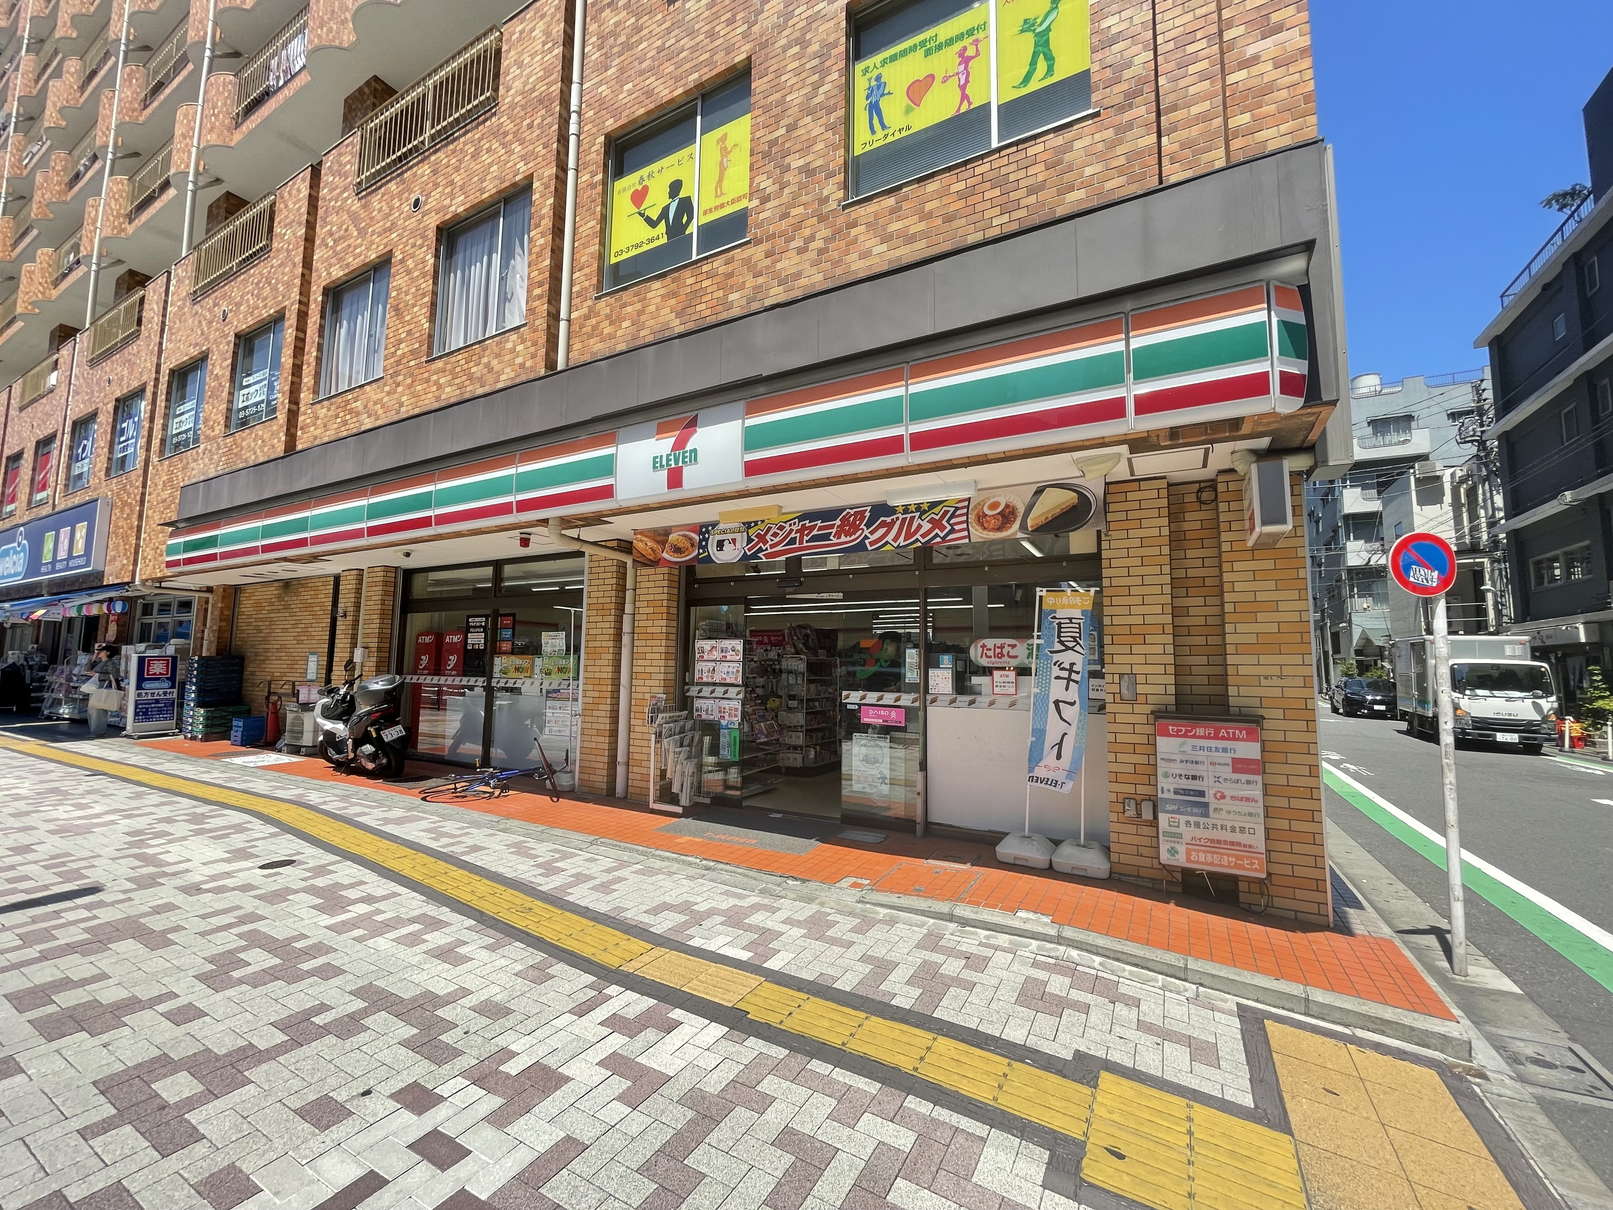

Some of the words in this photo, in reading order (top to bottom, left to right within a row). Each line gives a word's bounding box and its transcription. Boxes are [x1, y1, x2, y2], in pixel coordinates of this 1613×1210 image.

[861, 123, 913, 150] フリーダイヤル
[614, 233, 665, 258] 03-3792-3641
[446, 635, 459, 645] ATM
[980, 642, 1019, 660] たばこ
[136, 690, 175, 698] 処方せん受付
[1168, 726, 1214, 737] セブン銀行
[1219, 728, 1247, 739] ATM
[1191, 744, 1236, 754] 三井住友銀行
[1171, 773, 1204, 782] りそな銀行
